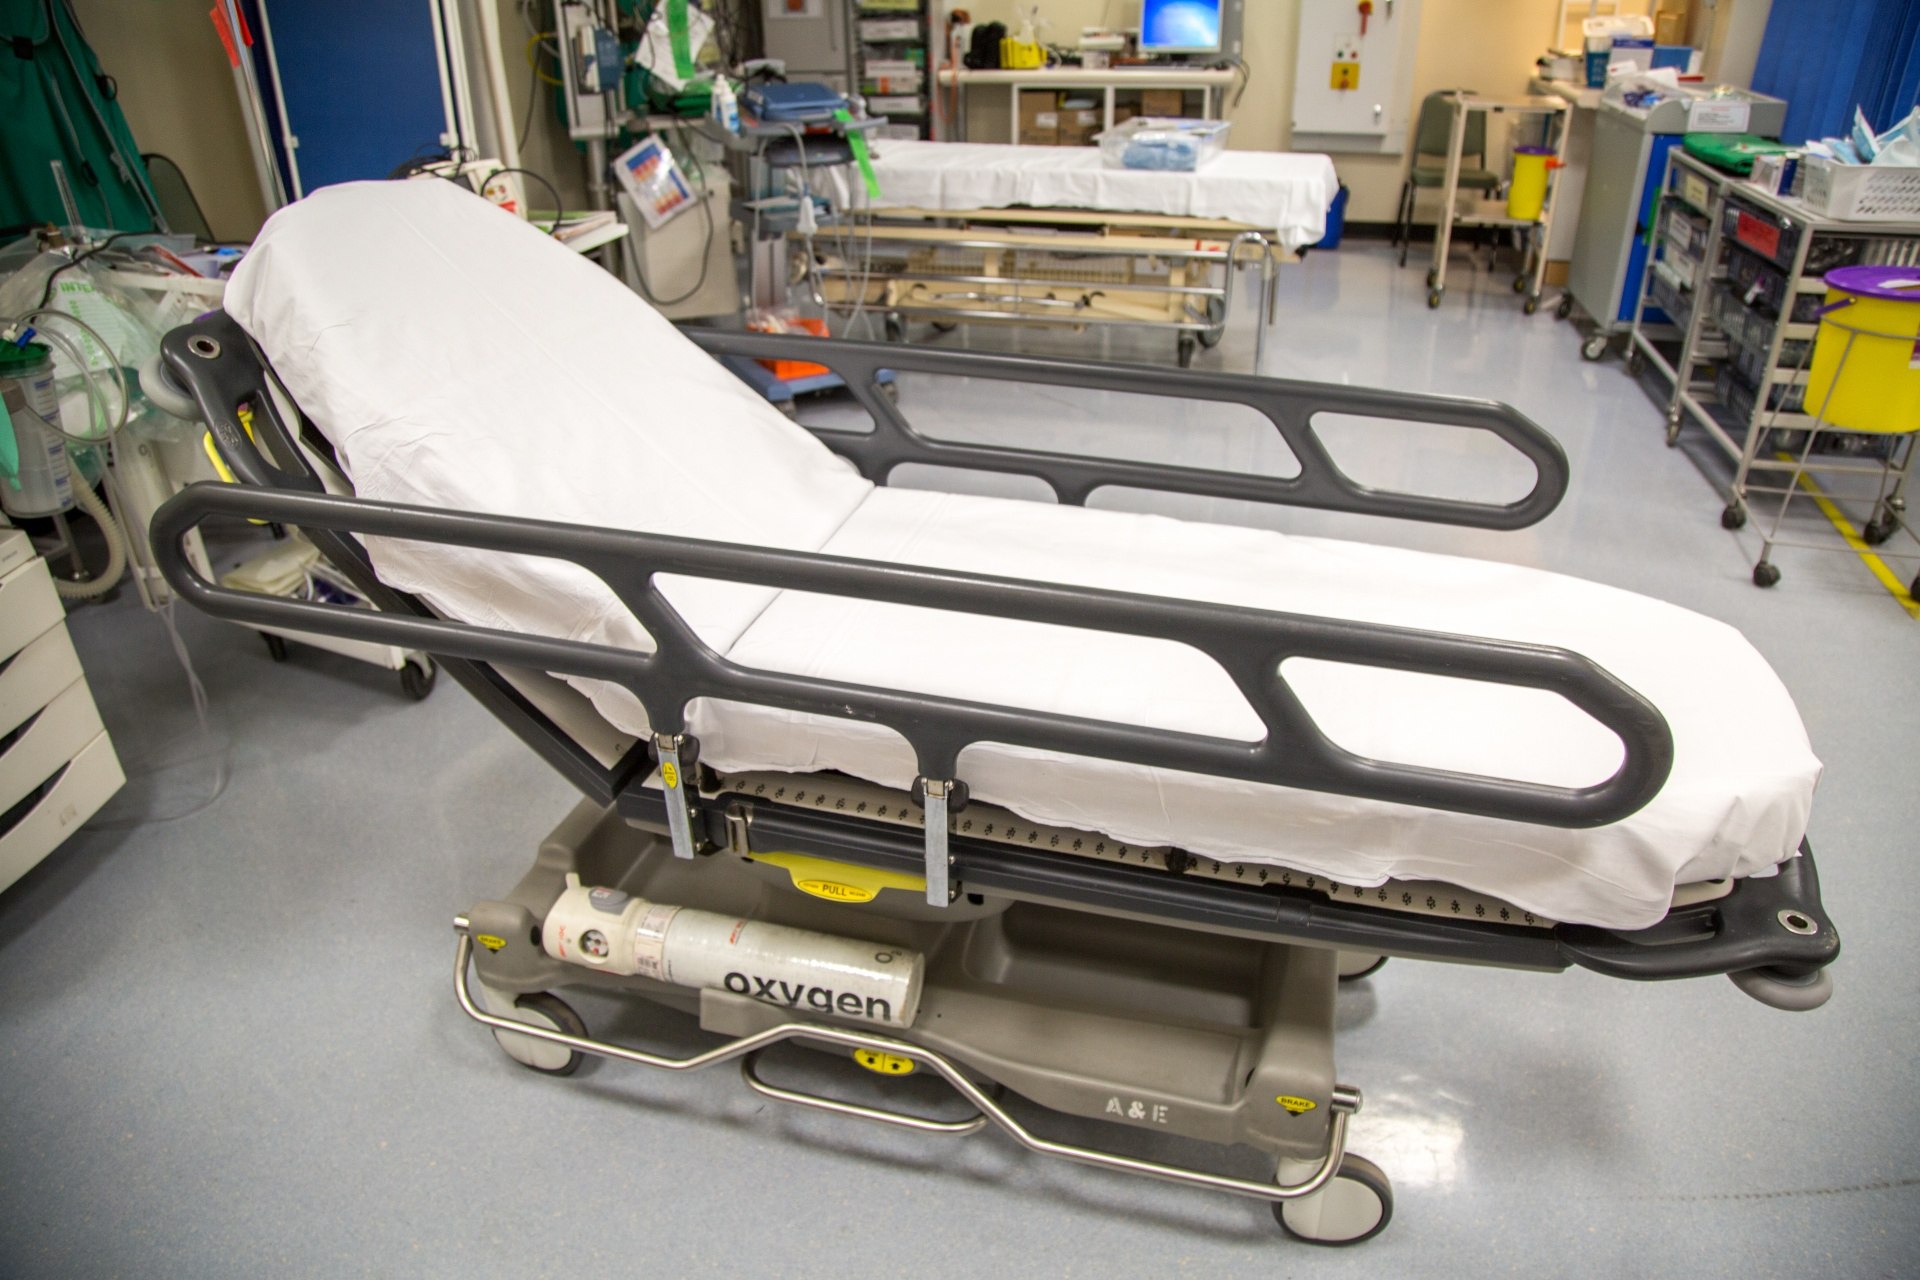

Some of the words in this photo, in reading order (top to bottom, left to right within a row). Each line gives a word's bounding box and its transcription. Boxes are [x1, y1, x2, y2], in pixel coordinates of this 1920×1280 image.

[822, 884, 847, 897] PULL
[724, 972, 892, 1022] oxygen
[1280, 1097, 1311, 1108] BRAKE
